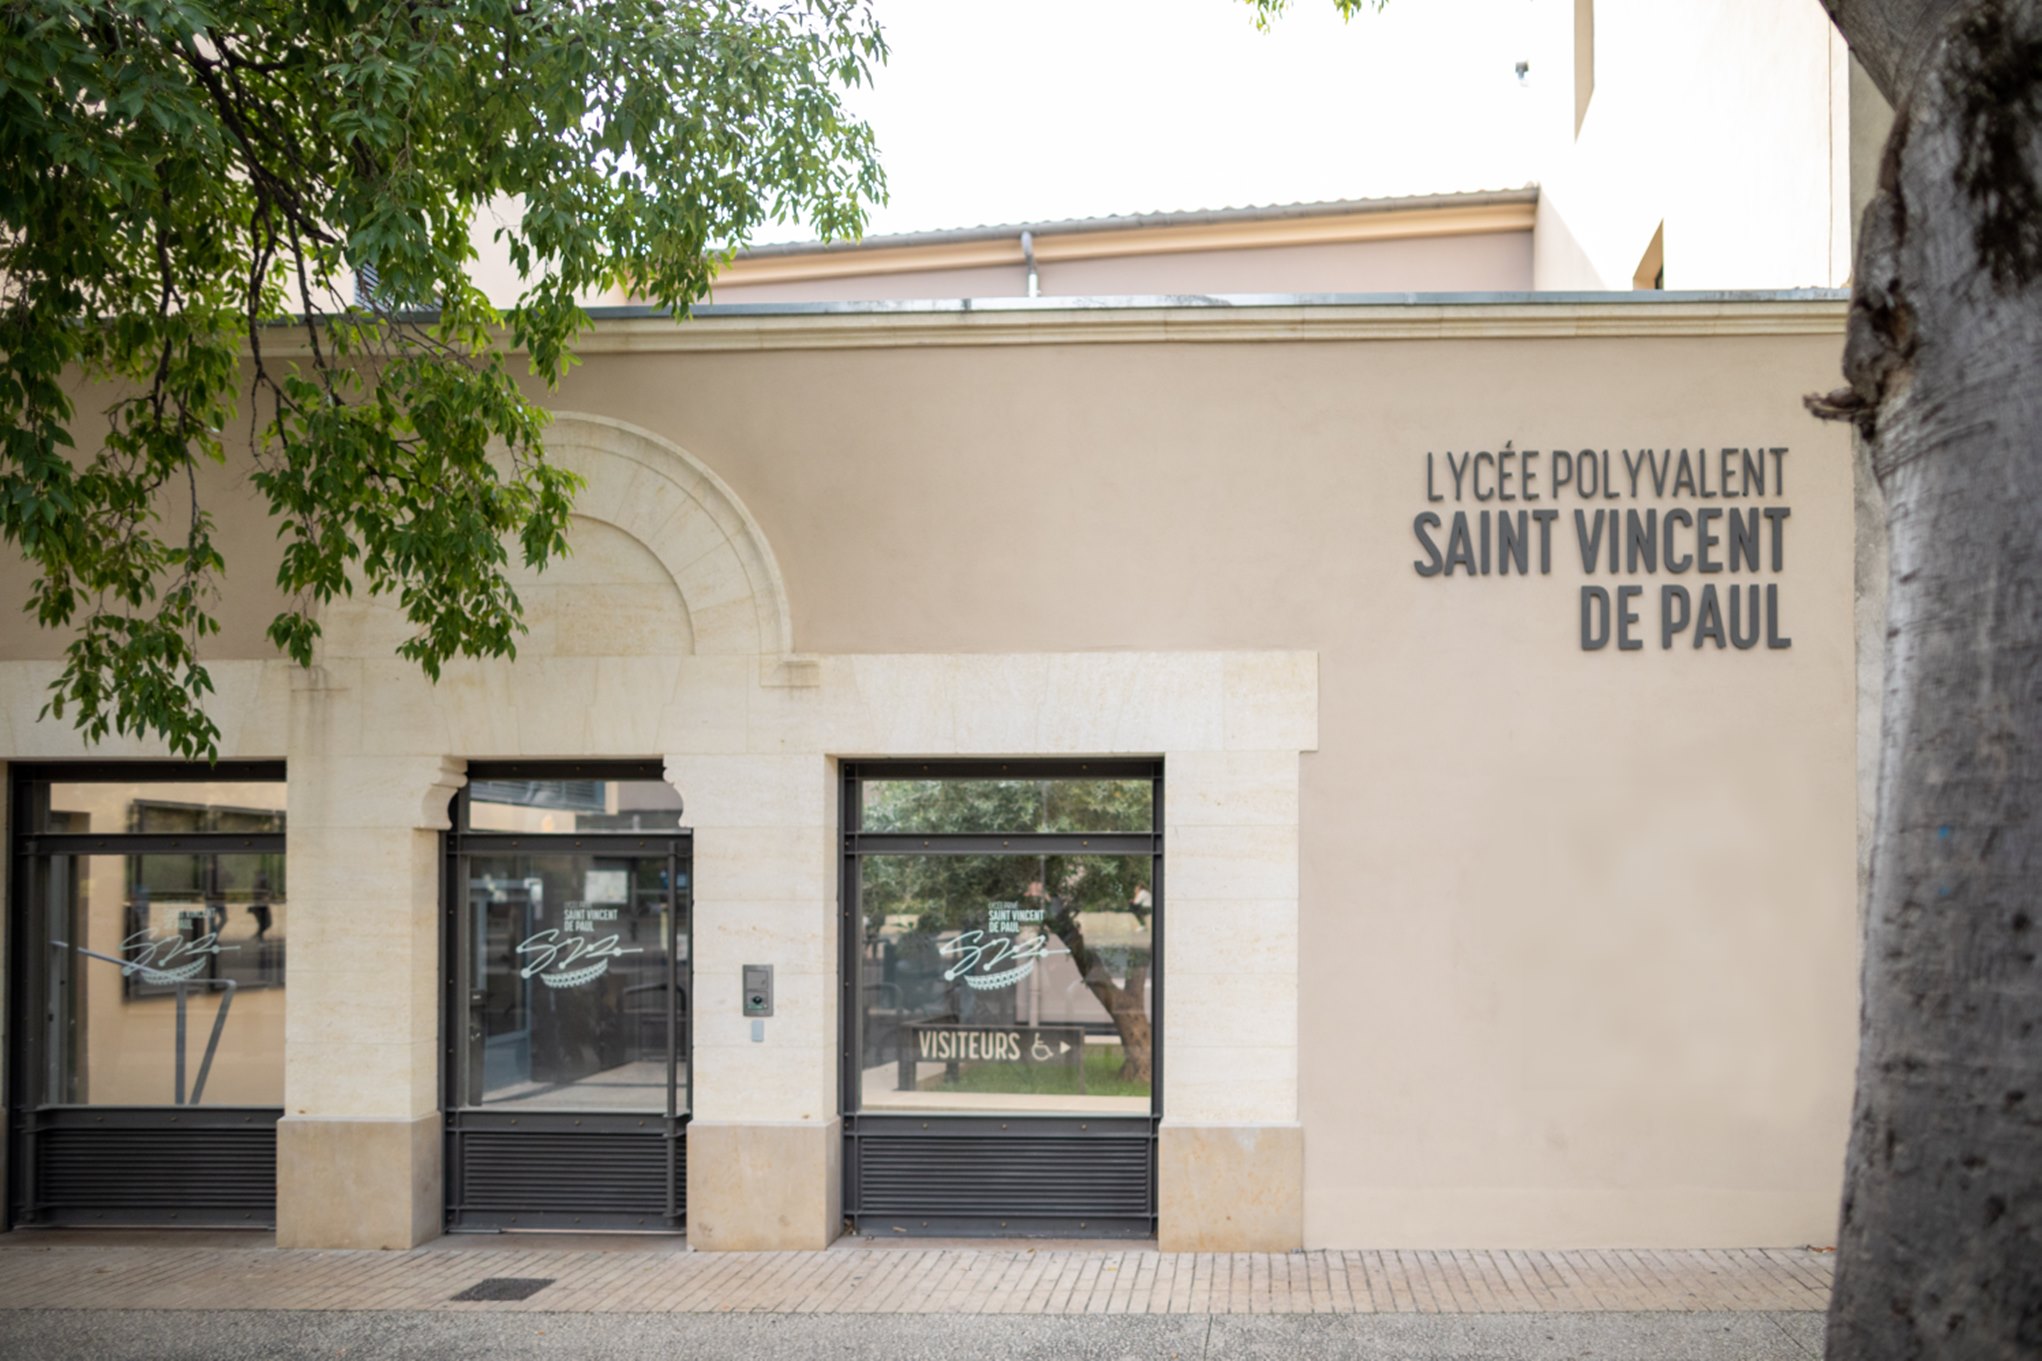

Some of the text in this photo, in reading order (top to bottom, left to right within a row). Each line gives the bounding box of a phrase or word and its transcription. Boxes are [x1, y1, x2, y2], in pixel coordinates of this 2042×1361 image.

[1427, 441, 1789, 502] LYCÉE POLYVALENT
[1413, 507, 1791, 578] SAINT VINCENT
[1580, 583, 1792, 651] DE PAUL
[564, 909, 618, 920] SAINT VINCENT
[988, 909, 1045, 921] SAINT VINCENT
[564, 920, 594, 932] DE PAUL
[988, 921, 1019, 933] DE PAUL
[919, 1031, 1021, 1060] VISITEURS
